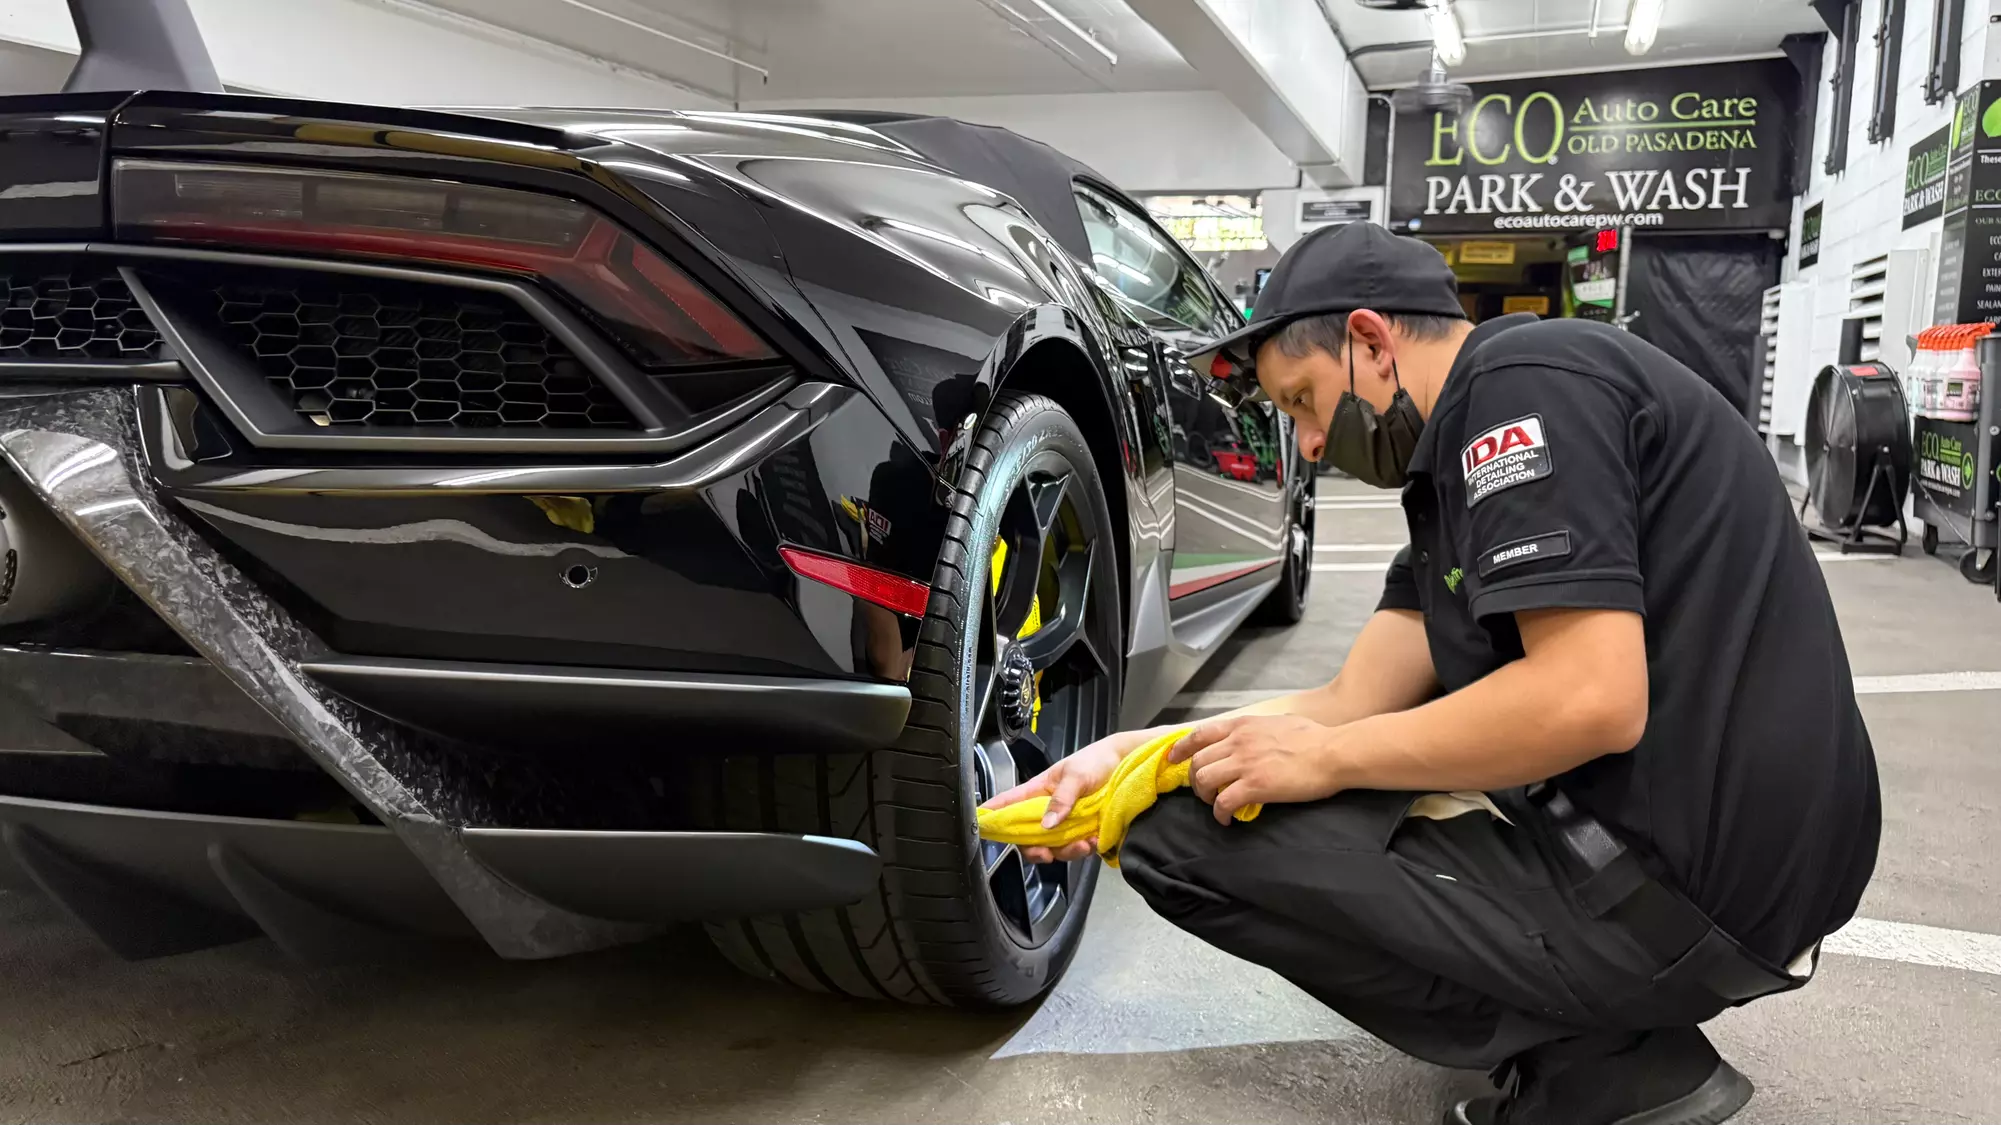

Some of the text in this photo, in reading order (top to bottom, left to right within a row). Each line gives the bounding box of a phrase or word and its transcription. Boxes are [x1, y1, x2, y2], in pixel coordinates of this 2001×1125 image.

[1571, 92, 1757, 124] Auto Care
[1424, 91, 1564, 166] ECO
[1567, 129, 1757, 154] OLD PASADENA
[1905, 151, 1929, 193] ECO
[1424, 167, 1752, 215] PARK & WASH
[1494, 211, 1664, 229] ecoautocarepw.com
[1465, 426, 1535, 474] IDA
[1921, 430, 1939, 460] ECO
[1468, 450, 1539, 486] INTERNATIONAL
[1476, 462, 1525, 488] DETAILING
[1941, 463, 1960, 487] WASH
[1474, 469, 1535, 500] ASSOCIATION
[1493, 543, 1539, 564] MEMBER
